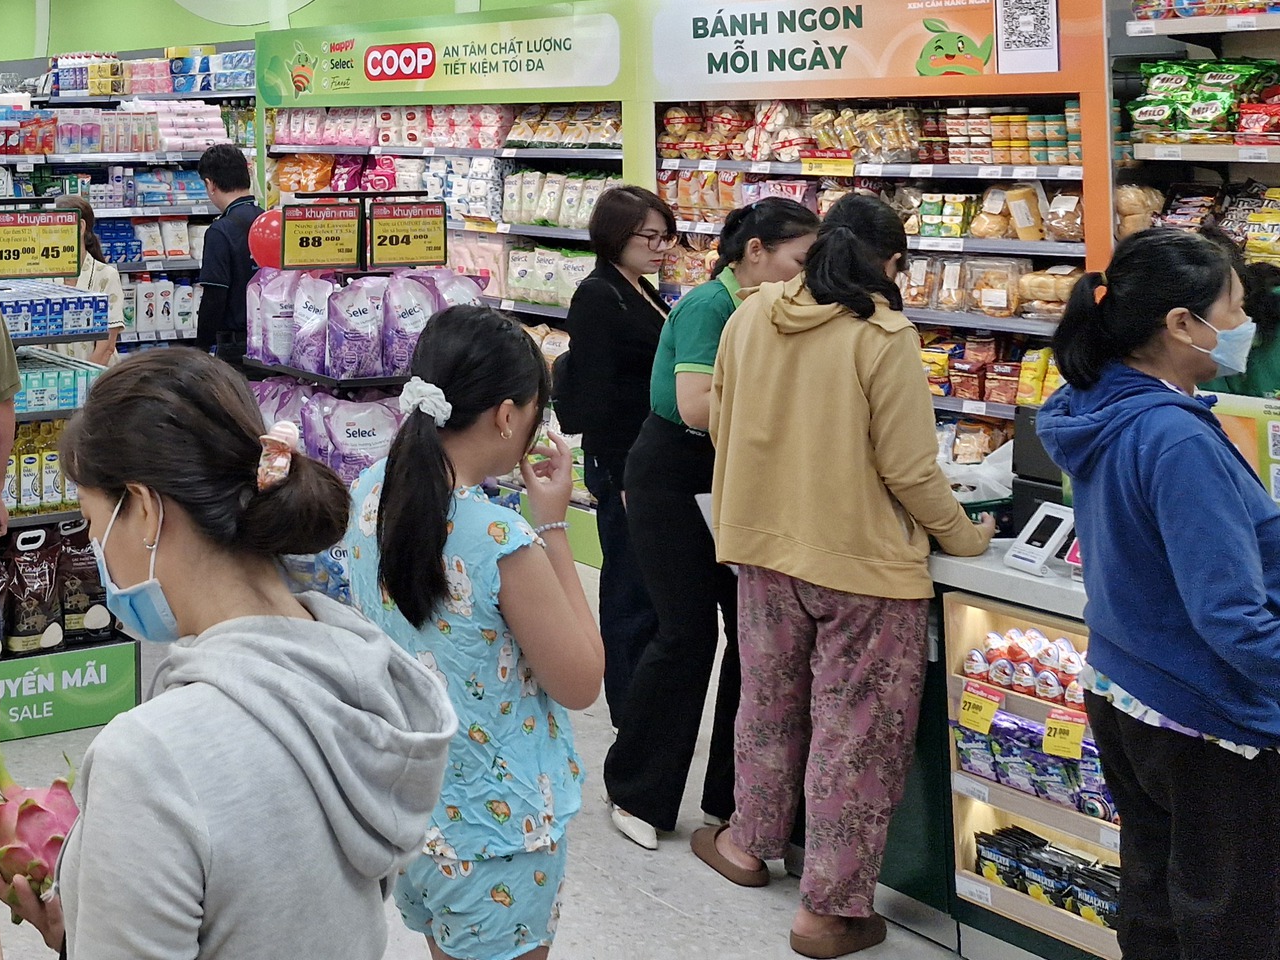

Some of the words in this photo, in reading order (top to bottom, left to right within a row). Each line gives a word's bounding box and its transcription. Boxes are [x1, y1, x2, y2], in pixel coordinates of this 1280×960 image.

[907, 1, 923, 9] XEM
[692, 9, 768, 39] BÁNH
[777, 4, 863, 34] NGON
[329, 39, 355, 53] Happy
[443, 45, 460, 58] AN
[462, 41, 487, 57] TÂM
[492, 37, 523, 56] CHẤT
[526, 37, 572, 55] LƯỢNG
[330, 58, 354, 70] Select
[366, 47, 433, 77] COOP
[707, 40, 758, 75] MỖI
[768, 40, 848, 72] NGÀY
[443, 56, 467, 75] TIẾT
[470, 57, 498, 78] KIỆM
[502, 54, 522, 73] TỐI
[525, 58, 545, 72] ĐA
[1158, 75, 1183, 85] MILO
[1207, 73, 1235, 81] MILO
[1138, 109, 1165, 118] MILO
[1191, 106, 1218, 116] MILO
[305, 207, 336, 220] khuyến
[393, 205, 424, 218] khuyến
[17, 213, 53, 226] khuyến
[279, 302, 294, 310] Sele
[346, 308, 369, 318] Sele
[345, 427, 376, 439] Select
[0, 667, 54, 699] YẾN
[62, 660, 106, 689] MÃI
[9, 701, 53, 723] SALE
[981, 848, 1010, 867] HIMALAYA
[1025, 868, 1055, 889] HIMALAYA
[1078, 890, 1109, 910] HIMALAYA
